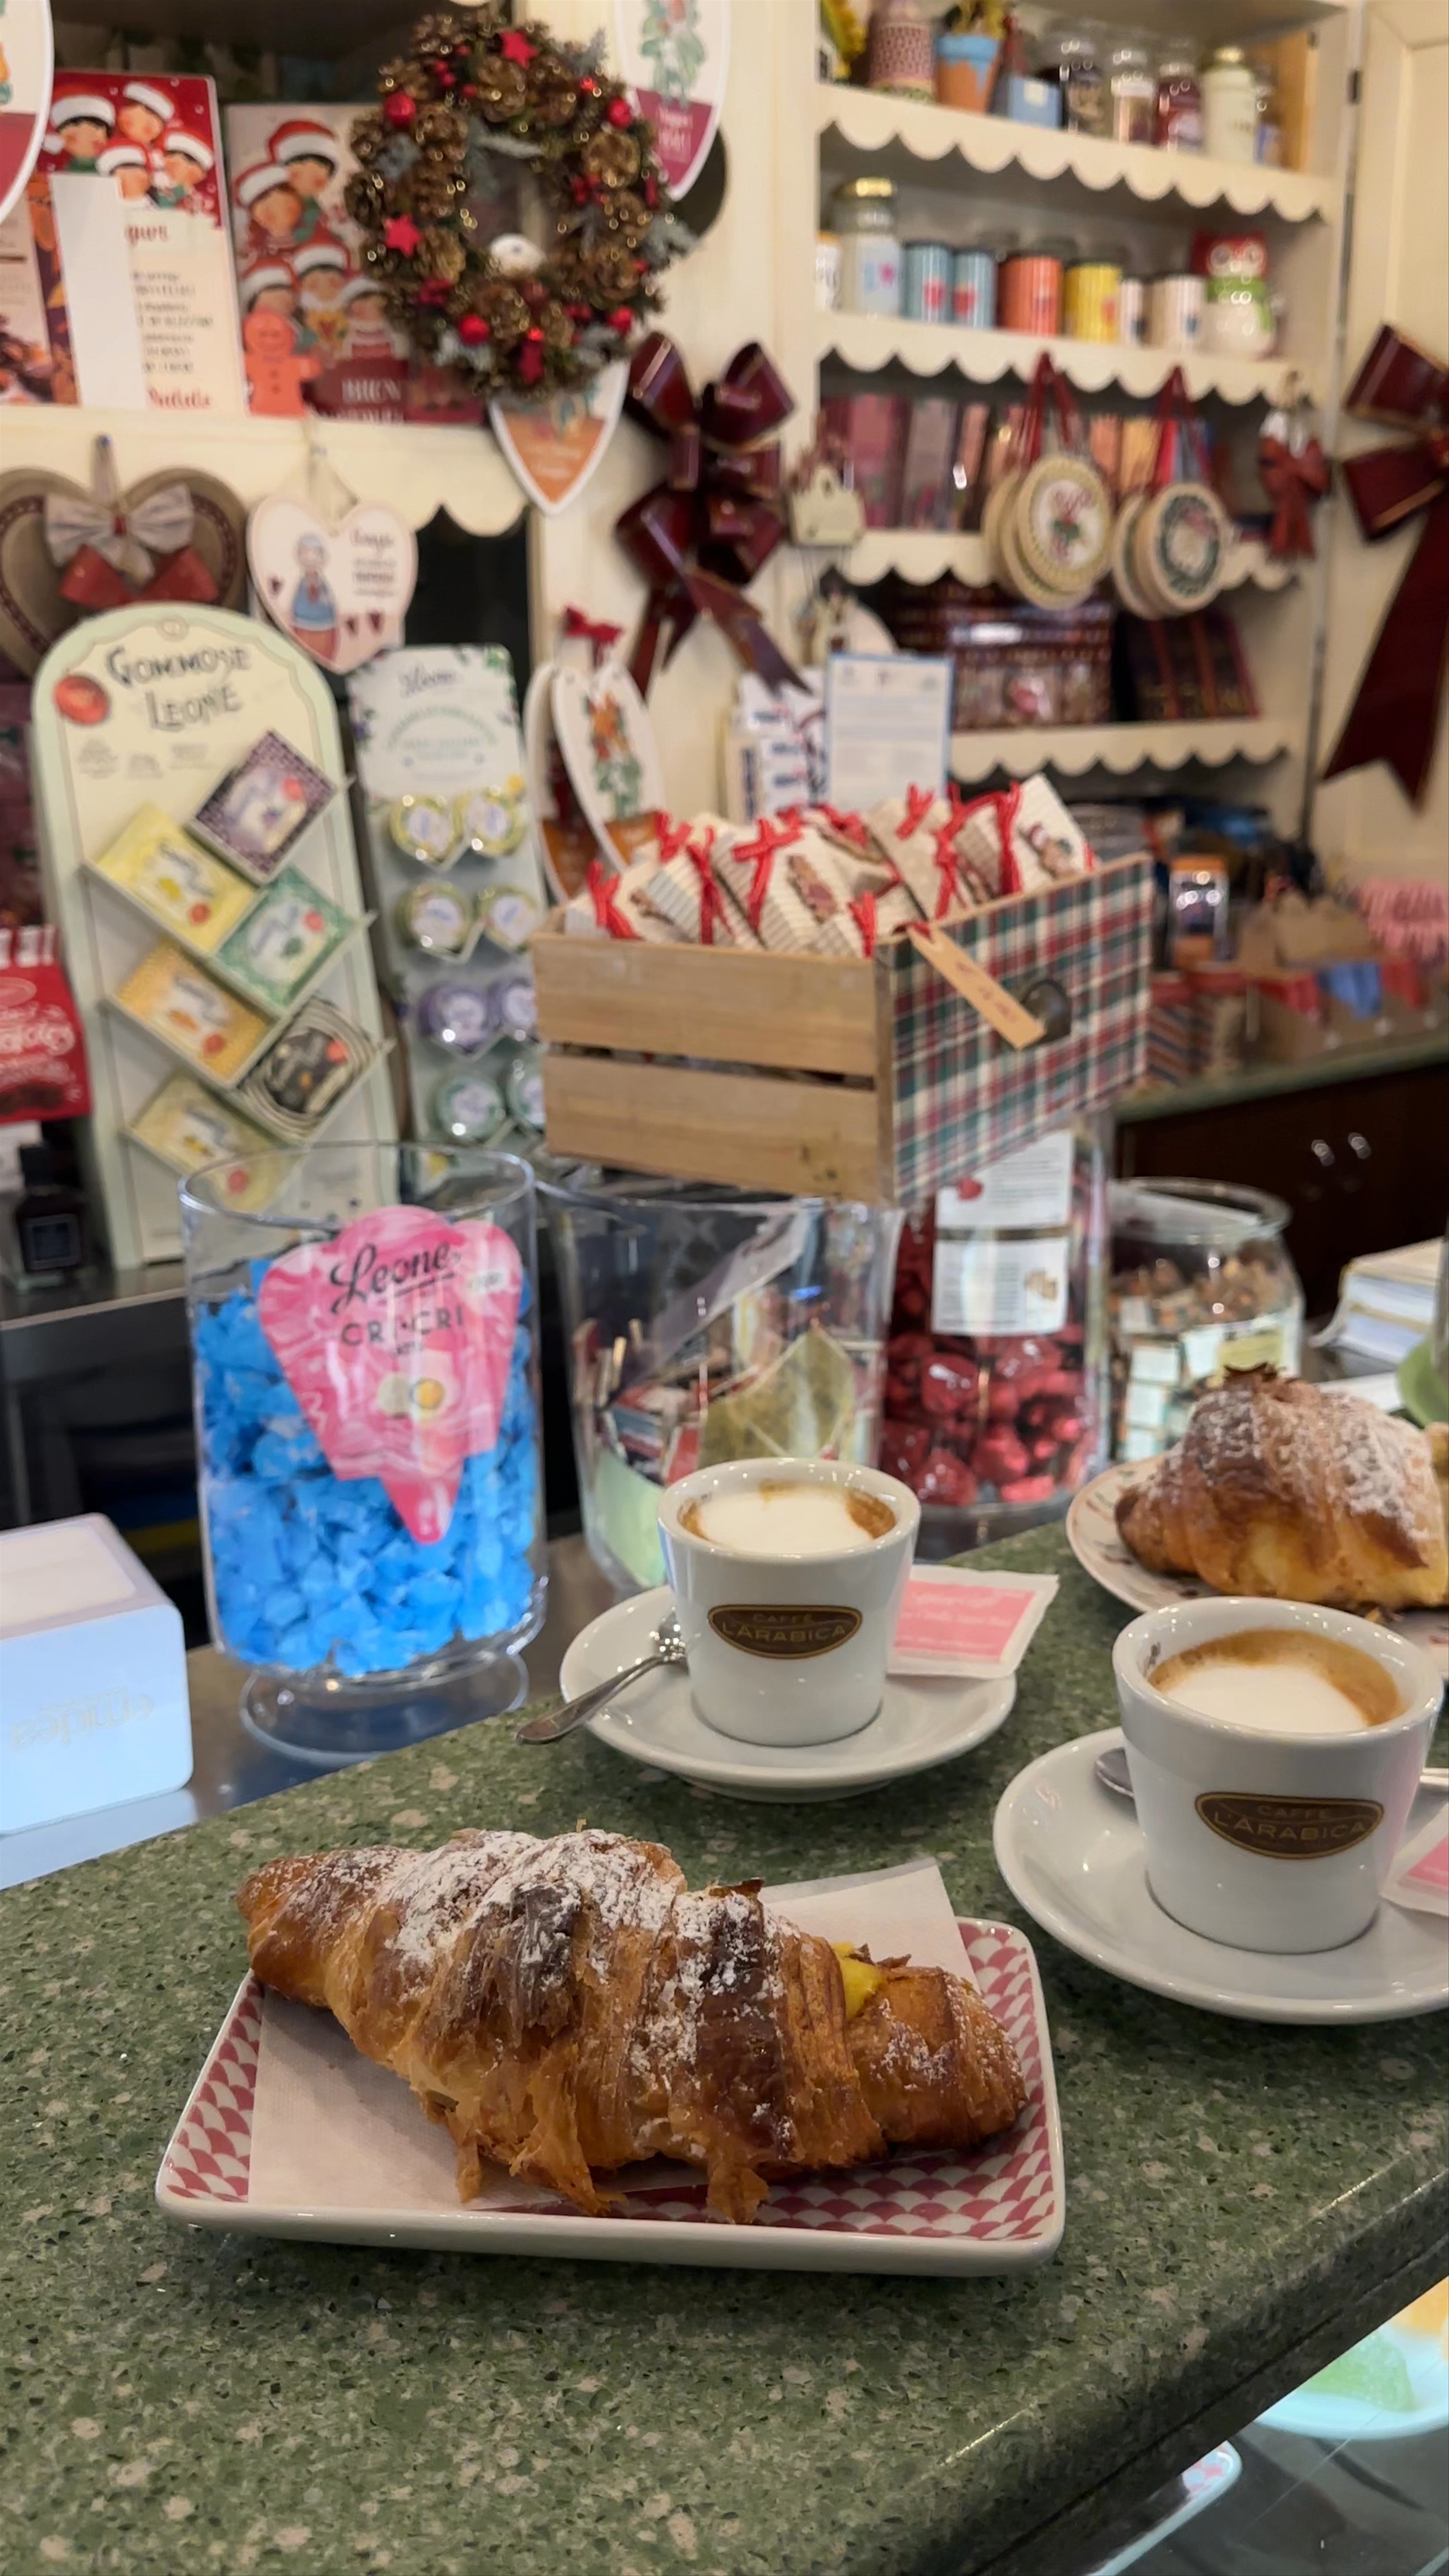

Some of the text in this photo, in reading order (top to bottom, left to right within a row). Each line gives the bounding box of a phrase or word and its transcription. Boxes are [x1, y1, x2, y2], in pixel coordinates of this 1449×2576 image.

[145, 682, 244, 733] LEONE
[329, 1243, 451, 1315] Leone
[1214, 1812, 1365, 1840] L'ARABICA
